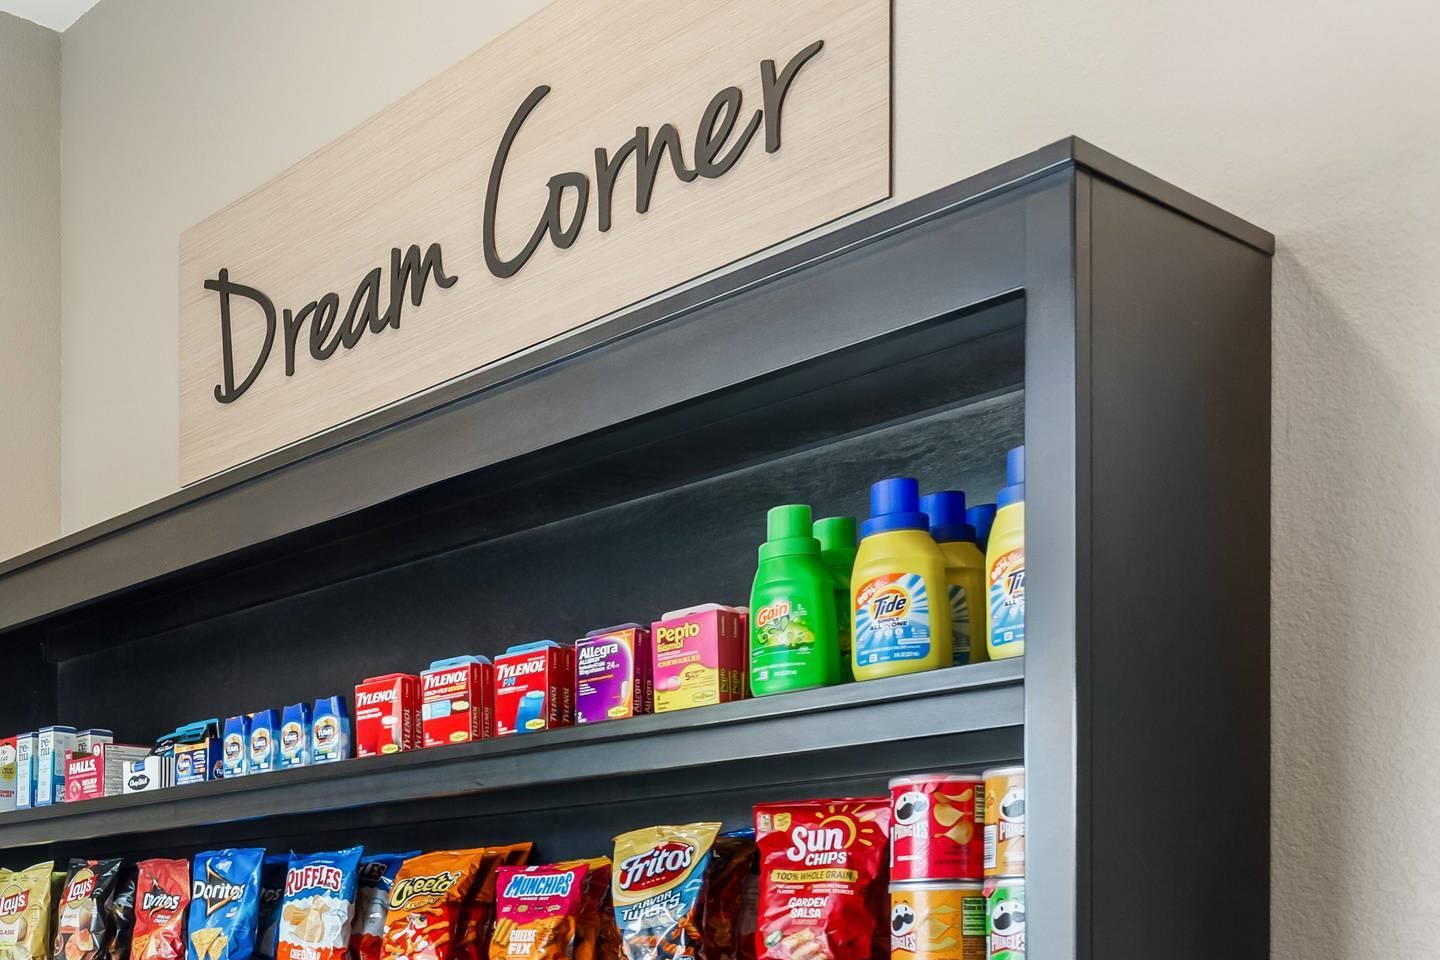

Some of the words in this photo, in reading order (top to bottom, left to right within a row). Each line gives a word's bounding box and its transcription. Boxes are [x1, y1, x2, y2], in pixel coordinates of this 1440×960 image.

[204, 242, 457, 404] Dream
[482, 39, 824, 279] Corner
[757, 601, 790, 626] Gain
[874, 595, 907, 619] Tide
[656, 623, 700, 645] Pepto
[579, 643, 618, 660] Allegra
[424, 670, 468, 690] TYLENOL
[497, 659, 545, 682] TYLENOL
[502, 677, 516, 688] PM
[357, 689, 398, 707] TYLENOL
[69, 759, 96, 775] HALLS
[786, 825, 843, 861] Sun
[620, 846, 694, 890] Fritos
[805, 852, 847, 866] CHIPS
[286, 866, 342, 896] RUFFLES
[504, 872, 575, 898] MUNCHIES
[776, 872, 799, 880] 100%
[800, 871, 824, 880] WHOLE
[825, 870, 852, 880] GRAIN
[67, 878, 93, 901] Lay's
[193, 881, 245, 901] Doritos
[633, 890, 672, 909] FLAVOR
[0, 892, 27, 916] Lay's
[143, 893, 180, 910] Doritos
[788, 896, 829, 908] GARDEN
[790, 907, 821, 918] SALSA
[508, 943, 531, 955] FIX
